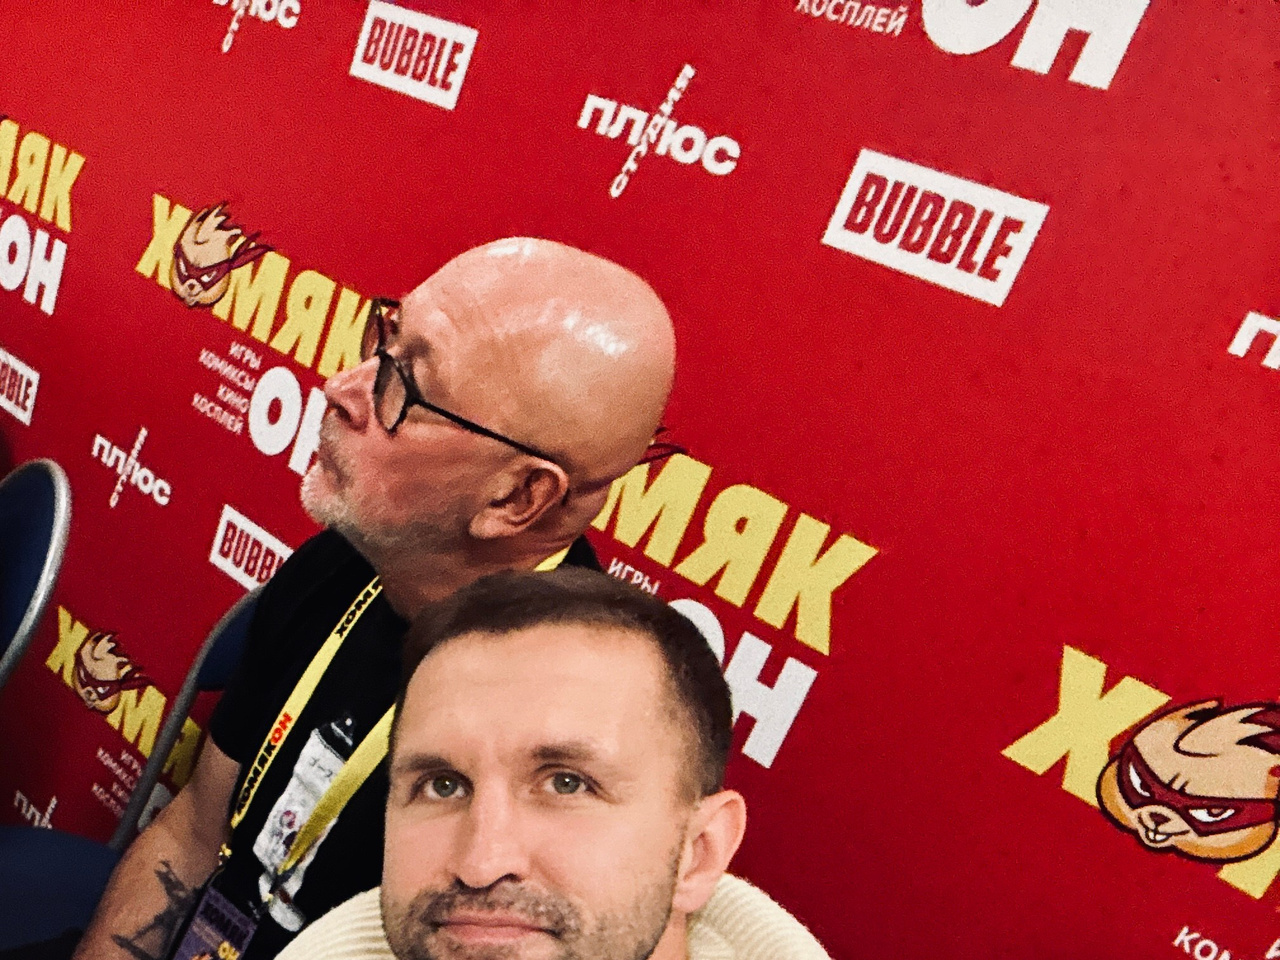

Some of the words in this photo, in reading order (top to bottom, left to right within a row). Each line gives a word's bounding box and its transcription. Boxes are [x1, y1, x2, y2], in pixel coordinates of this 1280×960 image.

[362, 12, 465, 94] BUBBLE
[843, 172, 1024, 283] BUBBLE
[219, 520, 285, 584] BUBB
[591, 452, 880, 656] МЯК
[607, 557, 661, 596] ИГРЫ
